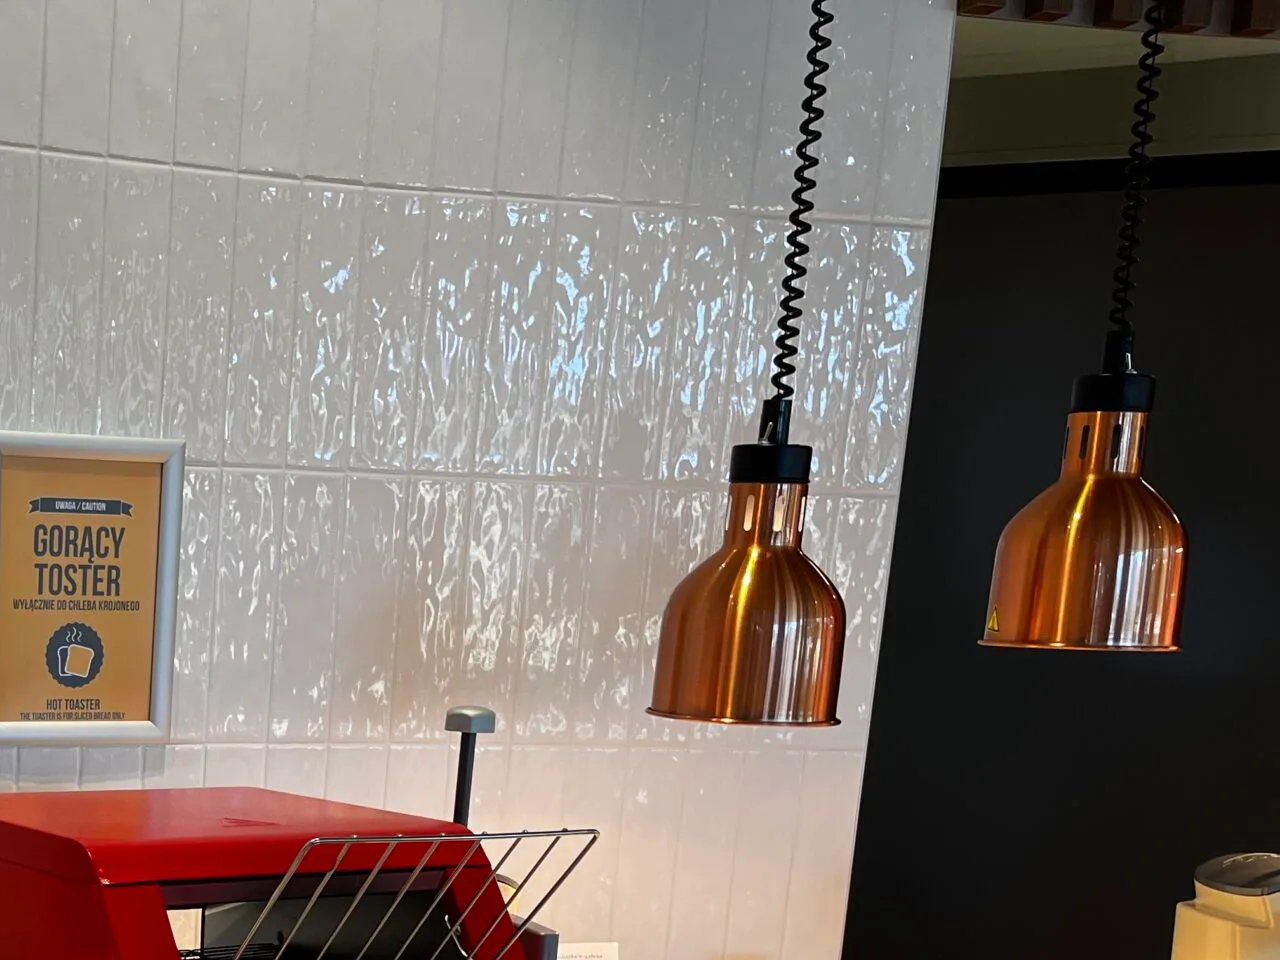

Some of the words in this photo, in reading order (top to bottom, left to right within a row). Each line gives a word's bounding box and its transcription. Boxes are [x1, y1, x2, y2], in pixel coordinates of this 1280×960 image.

[55, 501, 76, 510] UWAGA
[81, 502, 107, 511] CAUTION
[33, 524, 126, 564] GORĄCY
[34, 563, 121, 597] TOSTER
[13, 599, 55, 611] WYŁĄCZNIE
[56, 600, 67, 610] DO
[68, 600, 97, 611] CHLEBA
[99, 600, 140, 611] KROJONEGO
[46, 699, 62, 710] HOT
[64, 699, 101, 711] TOASTER
[20, 712, 30, 720] THE
[32, 712, 56, 720] TOASTER
